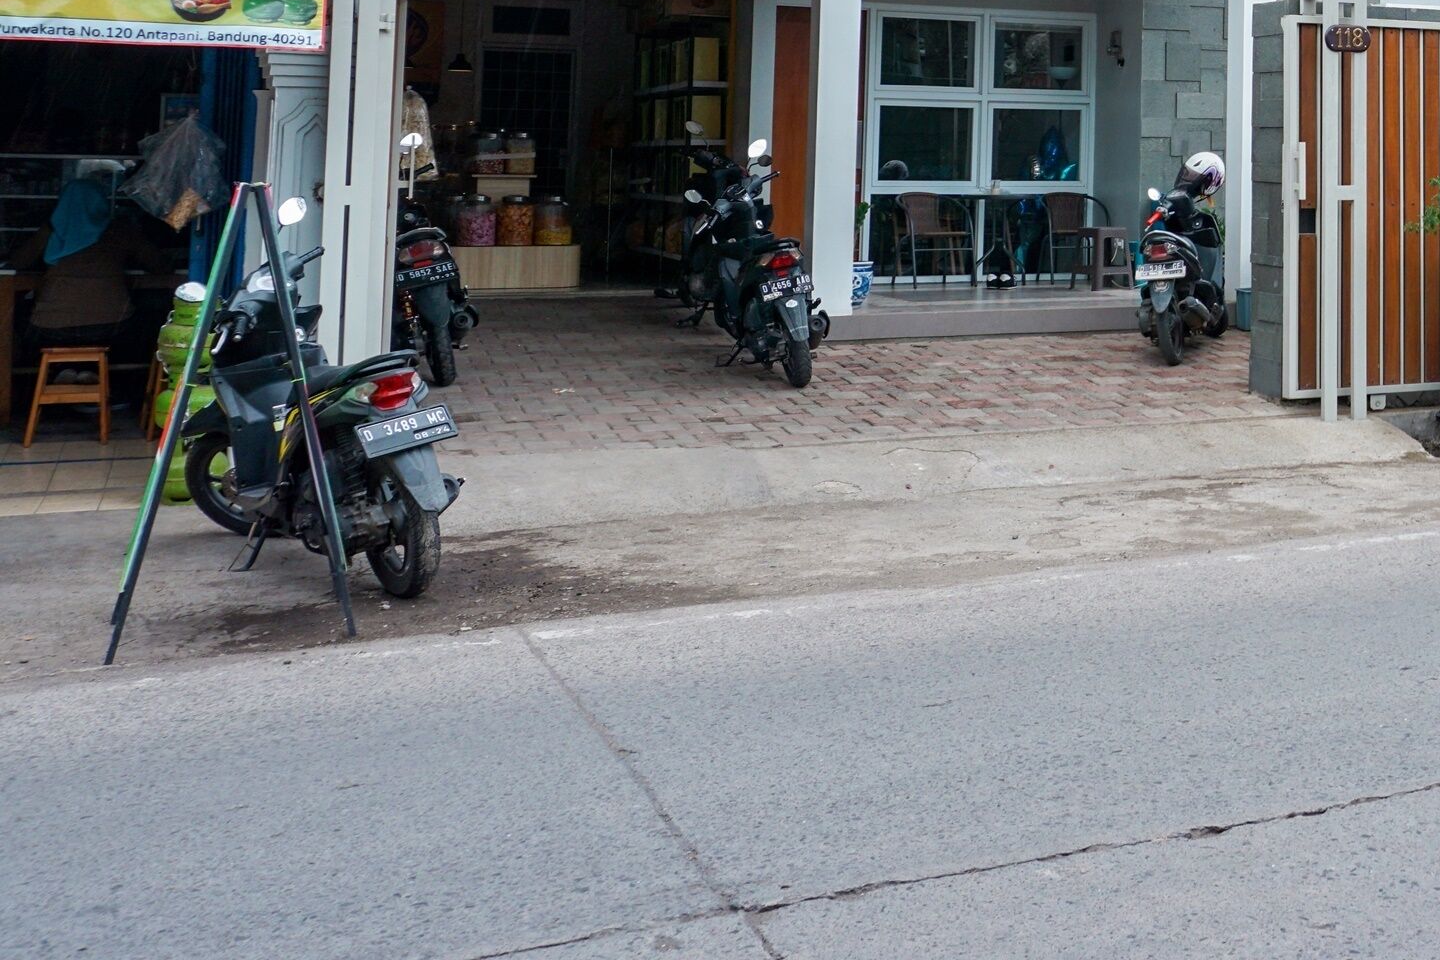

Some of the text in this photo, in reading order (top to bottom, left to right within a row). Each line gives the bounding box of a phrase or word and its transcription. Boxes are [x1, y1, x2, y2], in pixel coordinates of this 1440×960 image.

[0, 23, 76, 37] urwakarta
[80, 26, 133, 39] No.120
[1335, 27, 1364, 48] 118
[363, 411, 446, 442] D 3489 MC
